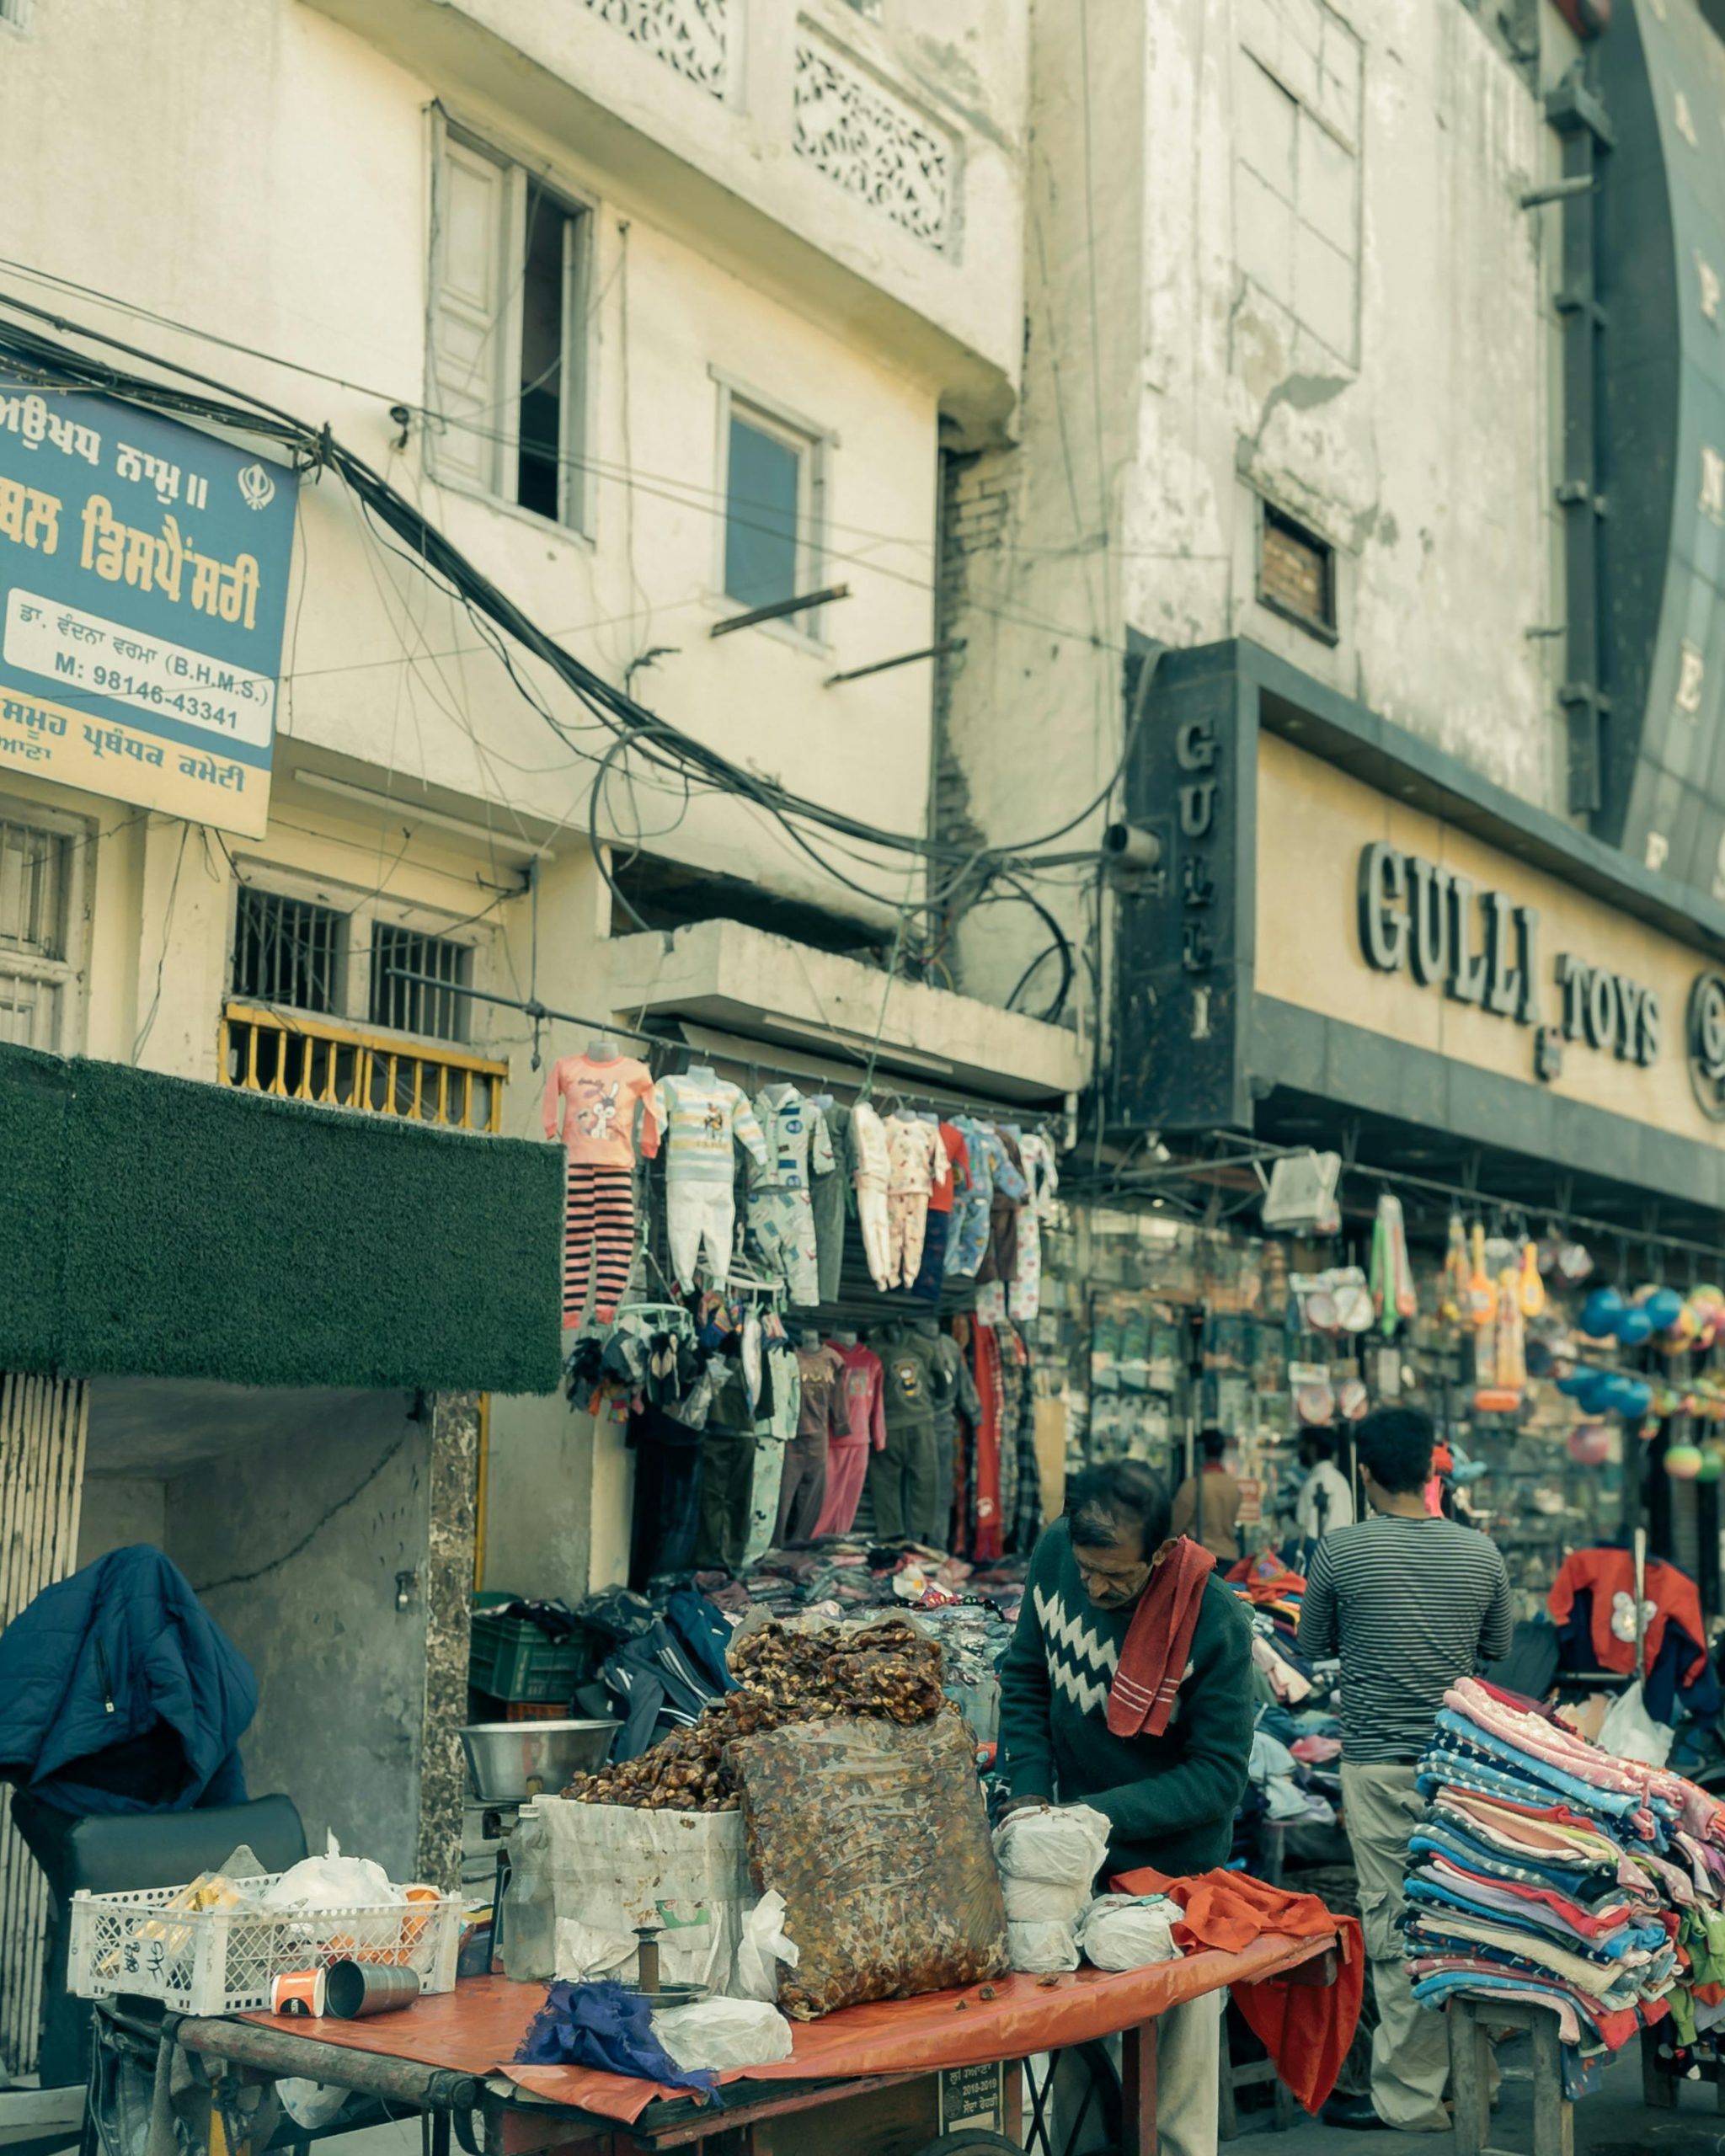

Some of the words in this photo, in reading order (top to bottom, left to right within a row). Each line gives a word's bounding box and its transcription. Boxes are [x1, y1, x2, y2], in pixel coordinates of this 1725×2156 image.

[81, 494, 260, 631] ਡਿਸਪੈਂਸਰੀ
[55, 652, 84, 680] M:
[93, 666, 238, 730] 98146-43341
[57, 613, 106, 646] ਵੰਦਨਾ
[113, 636, 159, 664] ਵਰਮਾ
[165, 654, 269, 707] (B.H.M.S.)
[3, 698, 67, 740] ਸਮੂਹ
[179, 753, 245, 792] ਕਮੇਟੀ
[1176, 719, 1219, 1041] GULLI
[1358, 841, 1541, 1026] GULLI
[1556, 953, 1663, 1070] TOYS
[962, 2078, 997, 2096] 2018-2019
